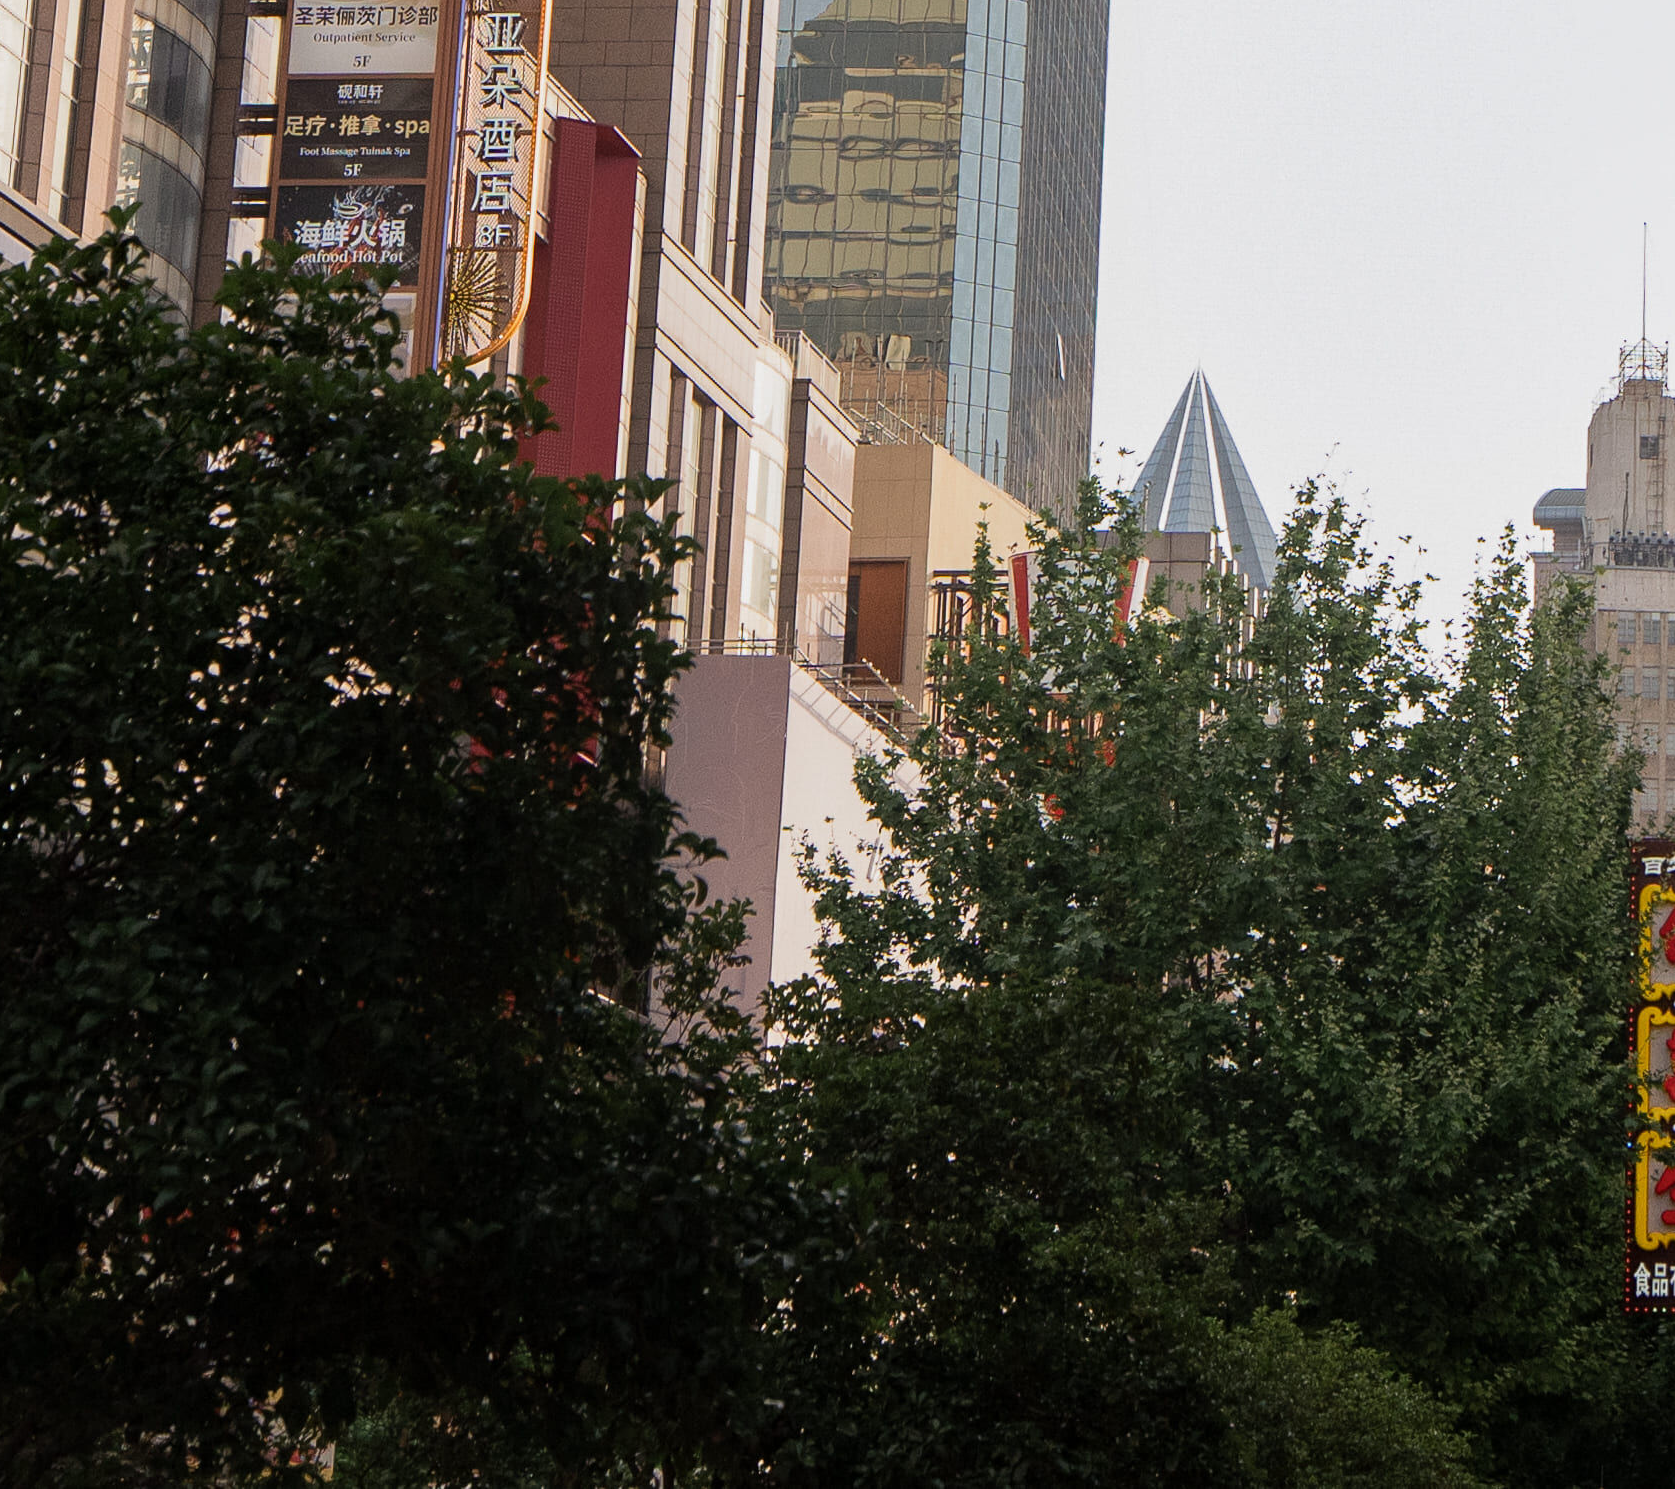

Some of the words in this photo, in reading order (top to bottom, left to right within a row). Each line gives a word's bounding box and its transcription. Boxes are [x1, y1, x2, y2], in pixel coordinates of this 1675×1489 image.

[313, 31, 372, 45] Outpatient
[375, 31, 416, 43] Service
[352, 54, 372, 68] 5F
[469, 11, 527, 213] 亚朵酒店
[299, 146, 320, 157] Foot
[321, 146, 359, 158] Massage
[393, 146, 411, 158] Spa
[343, 163, 364, 178] 5F
[293, 219, 407, 249] 海鲜火锅
[477, 223, 512, 247] 8F
[295, 250, 348, 264] eafood
[351, 250, 378, 264] Hot
[381, 250, 404, 264] Pot
